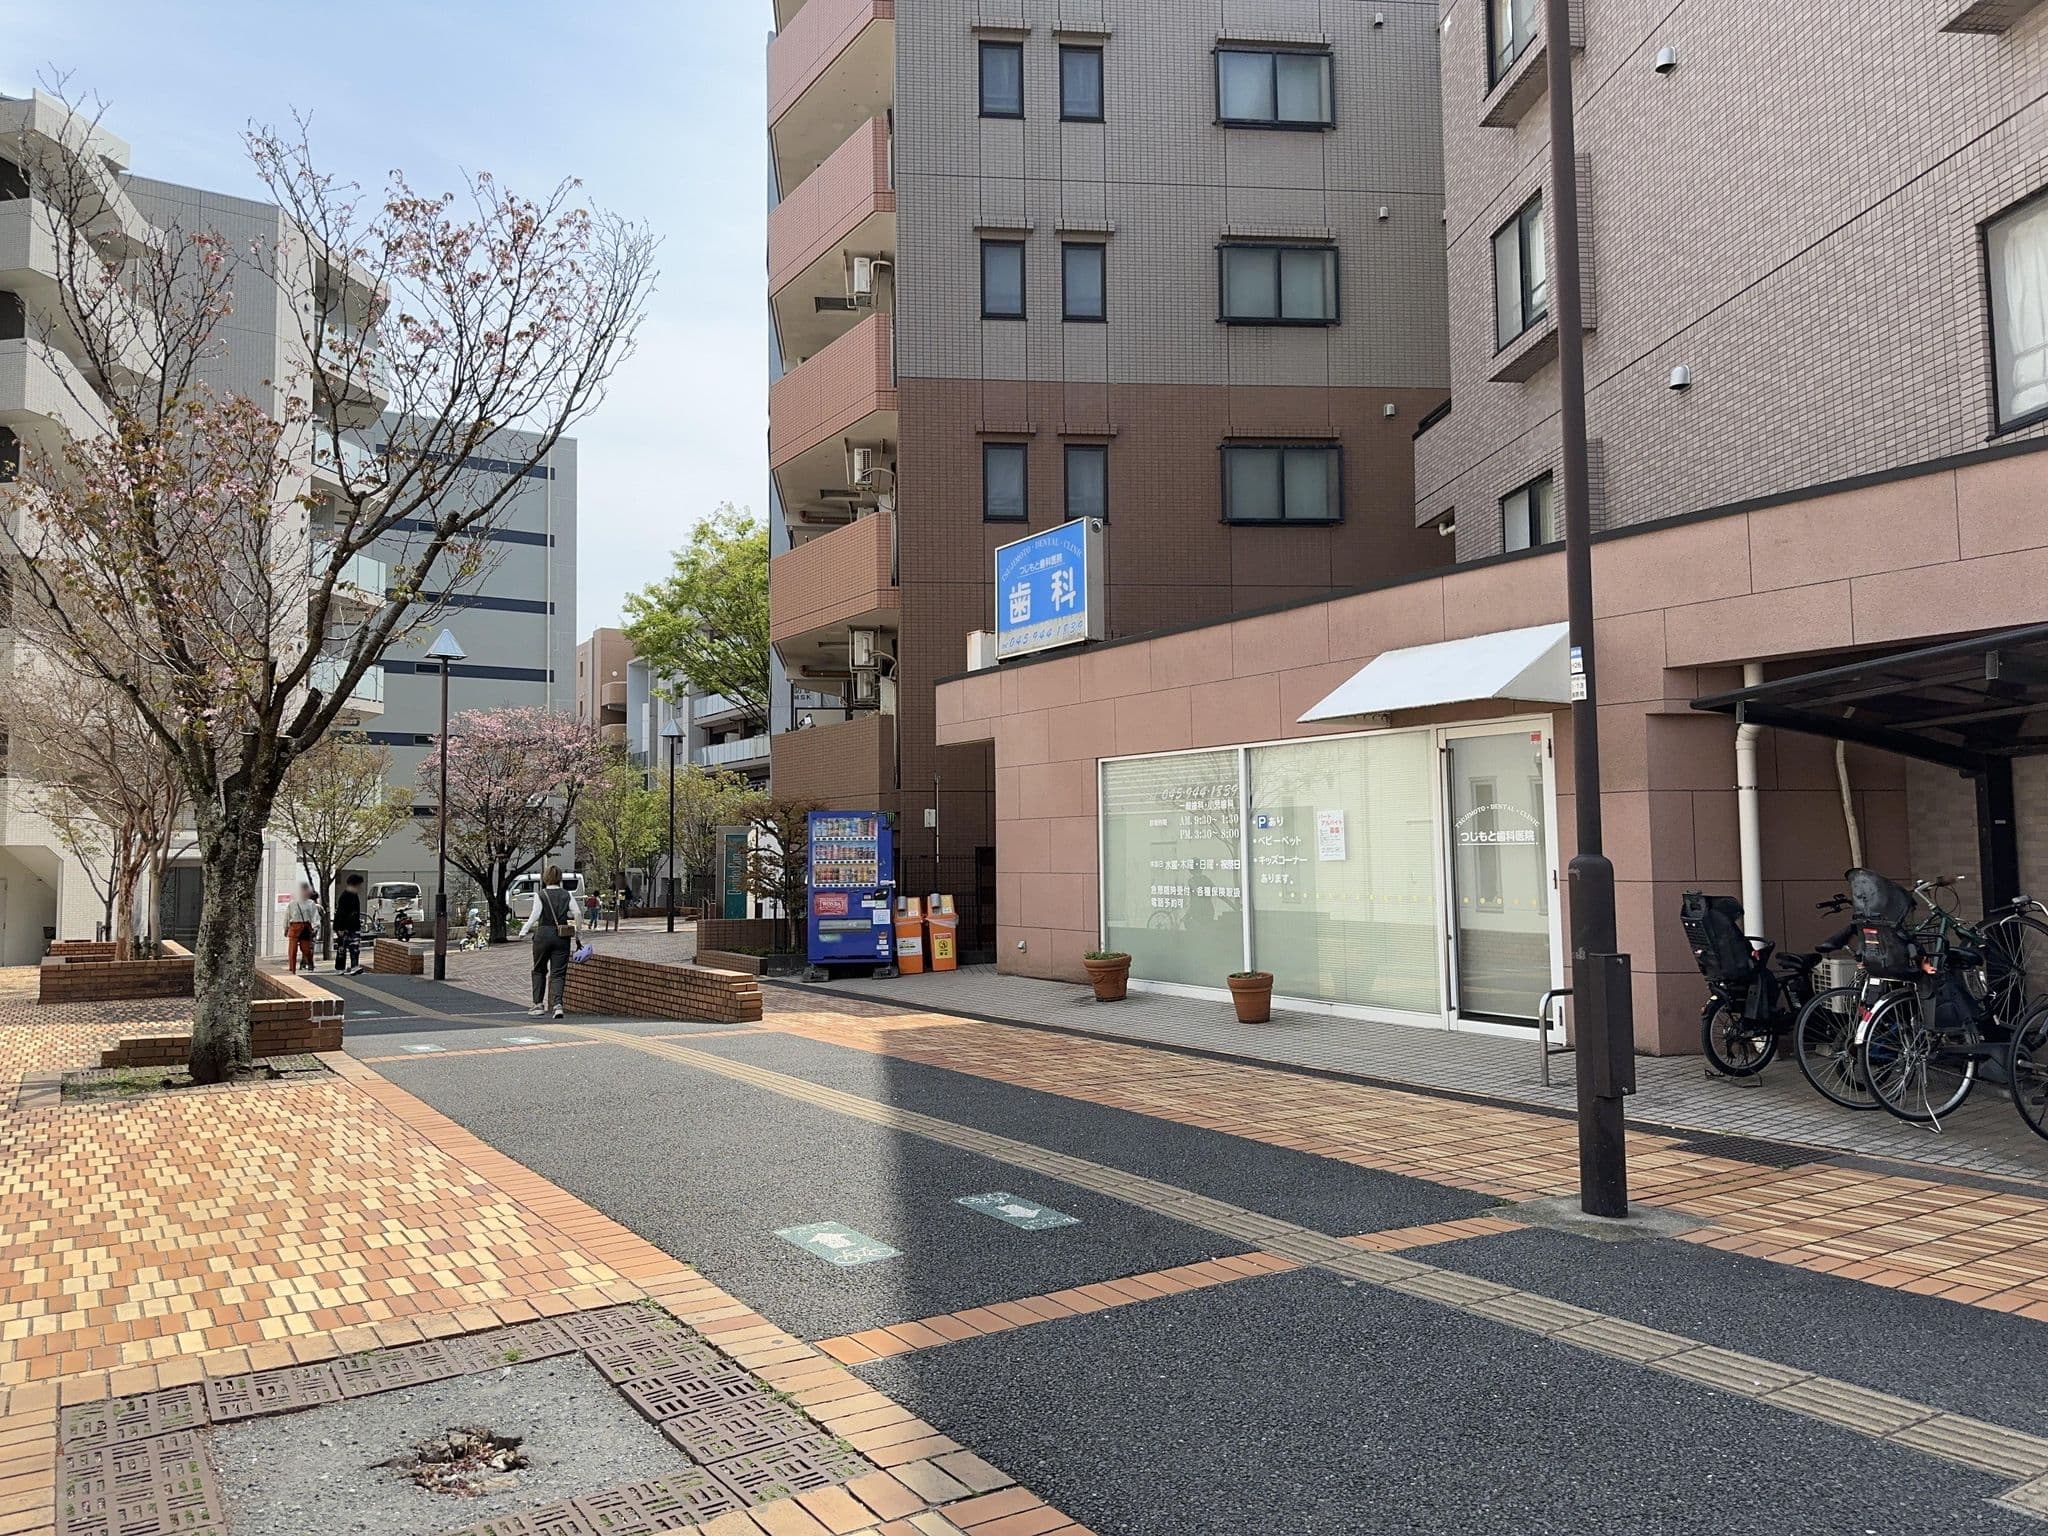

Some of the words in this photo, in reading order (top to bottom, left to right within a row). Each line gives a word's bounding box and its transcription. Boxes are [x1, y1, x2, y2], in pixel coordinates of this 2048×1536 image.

[1455, 805, 1486, 829] TSUJIMOTO
[1490, 803, 1515, 812] DENTAL
[1520, 810, 1540, 828] CLINIC
[1460, 829, 1535, 842] つじもと歯科医院
